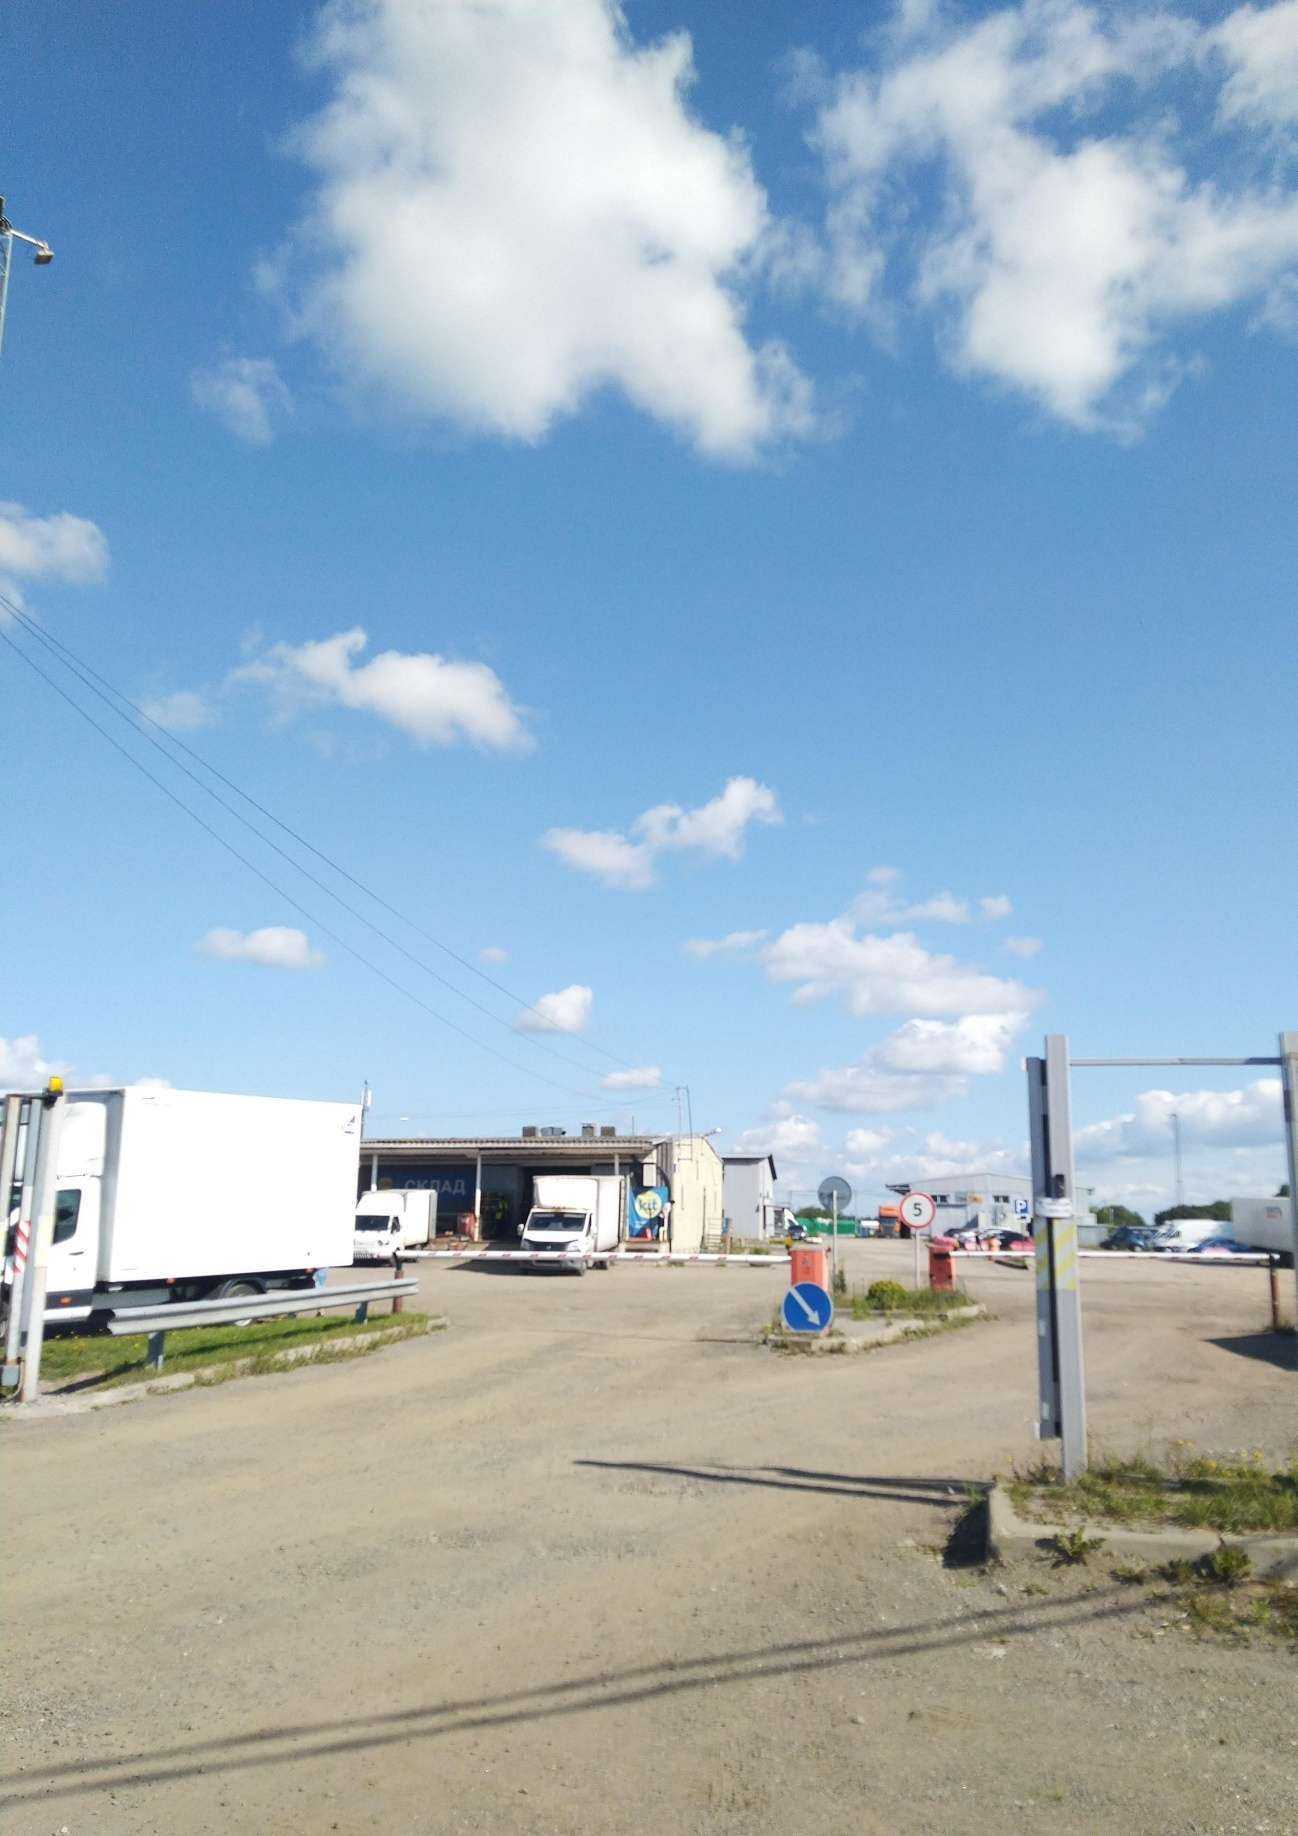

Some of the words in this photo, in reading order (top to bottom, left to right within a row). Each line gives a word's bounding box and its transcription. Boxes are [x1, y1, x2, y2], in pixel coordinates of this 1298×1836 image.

[404, 1179, 466, 1195] СКЛАД
[912, 1203, 922, 1216] 5
[1016, 1200, 1026, 1212] P
